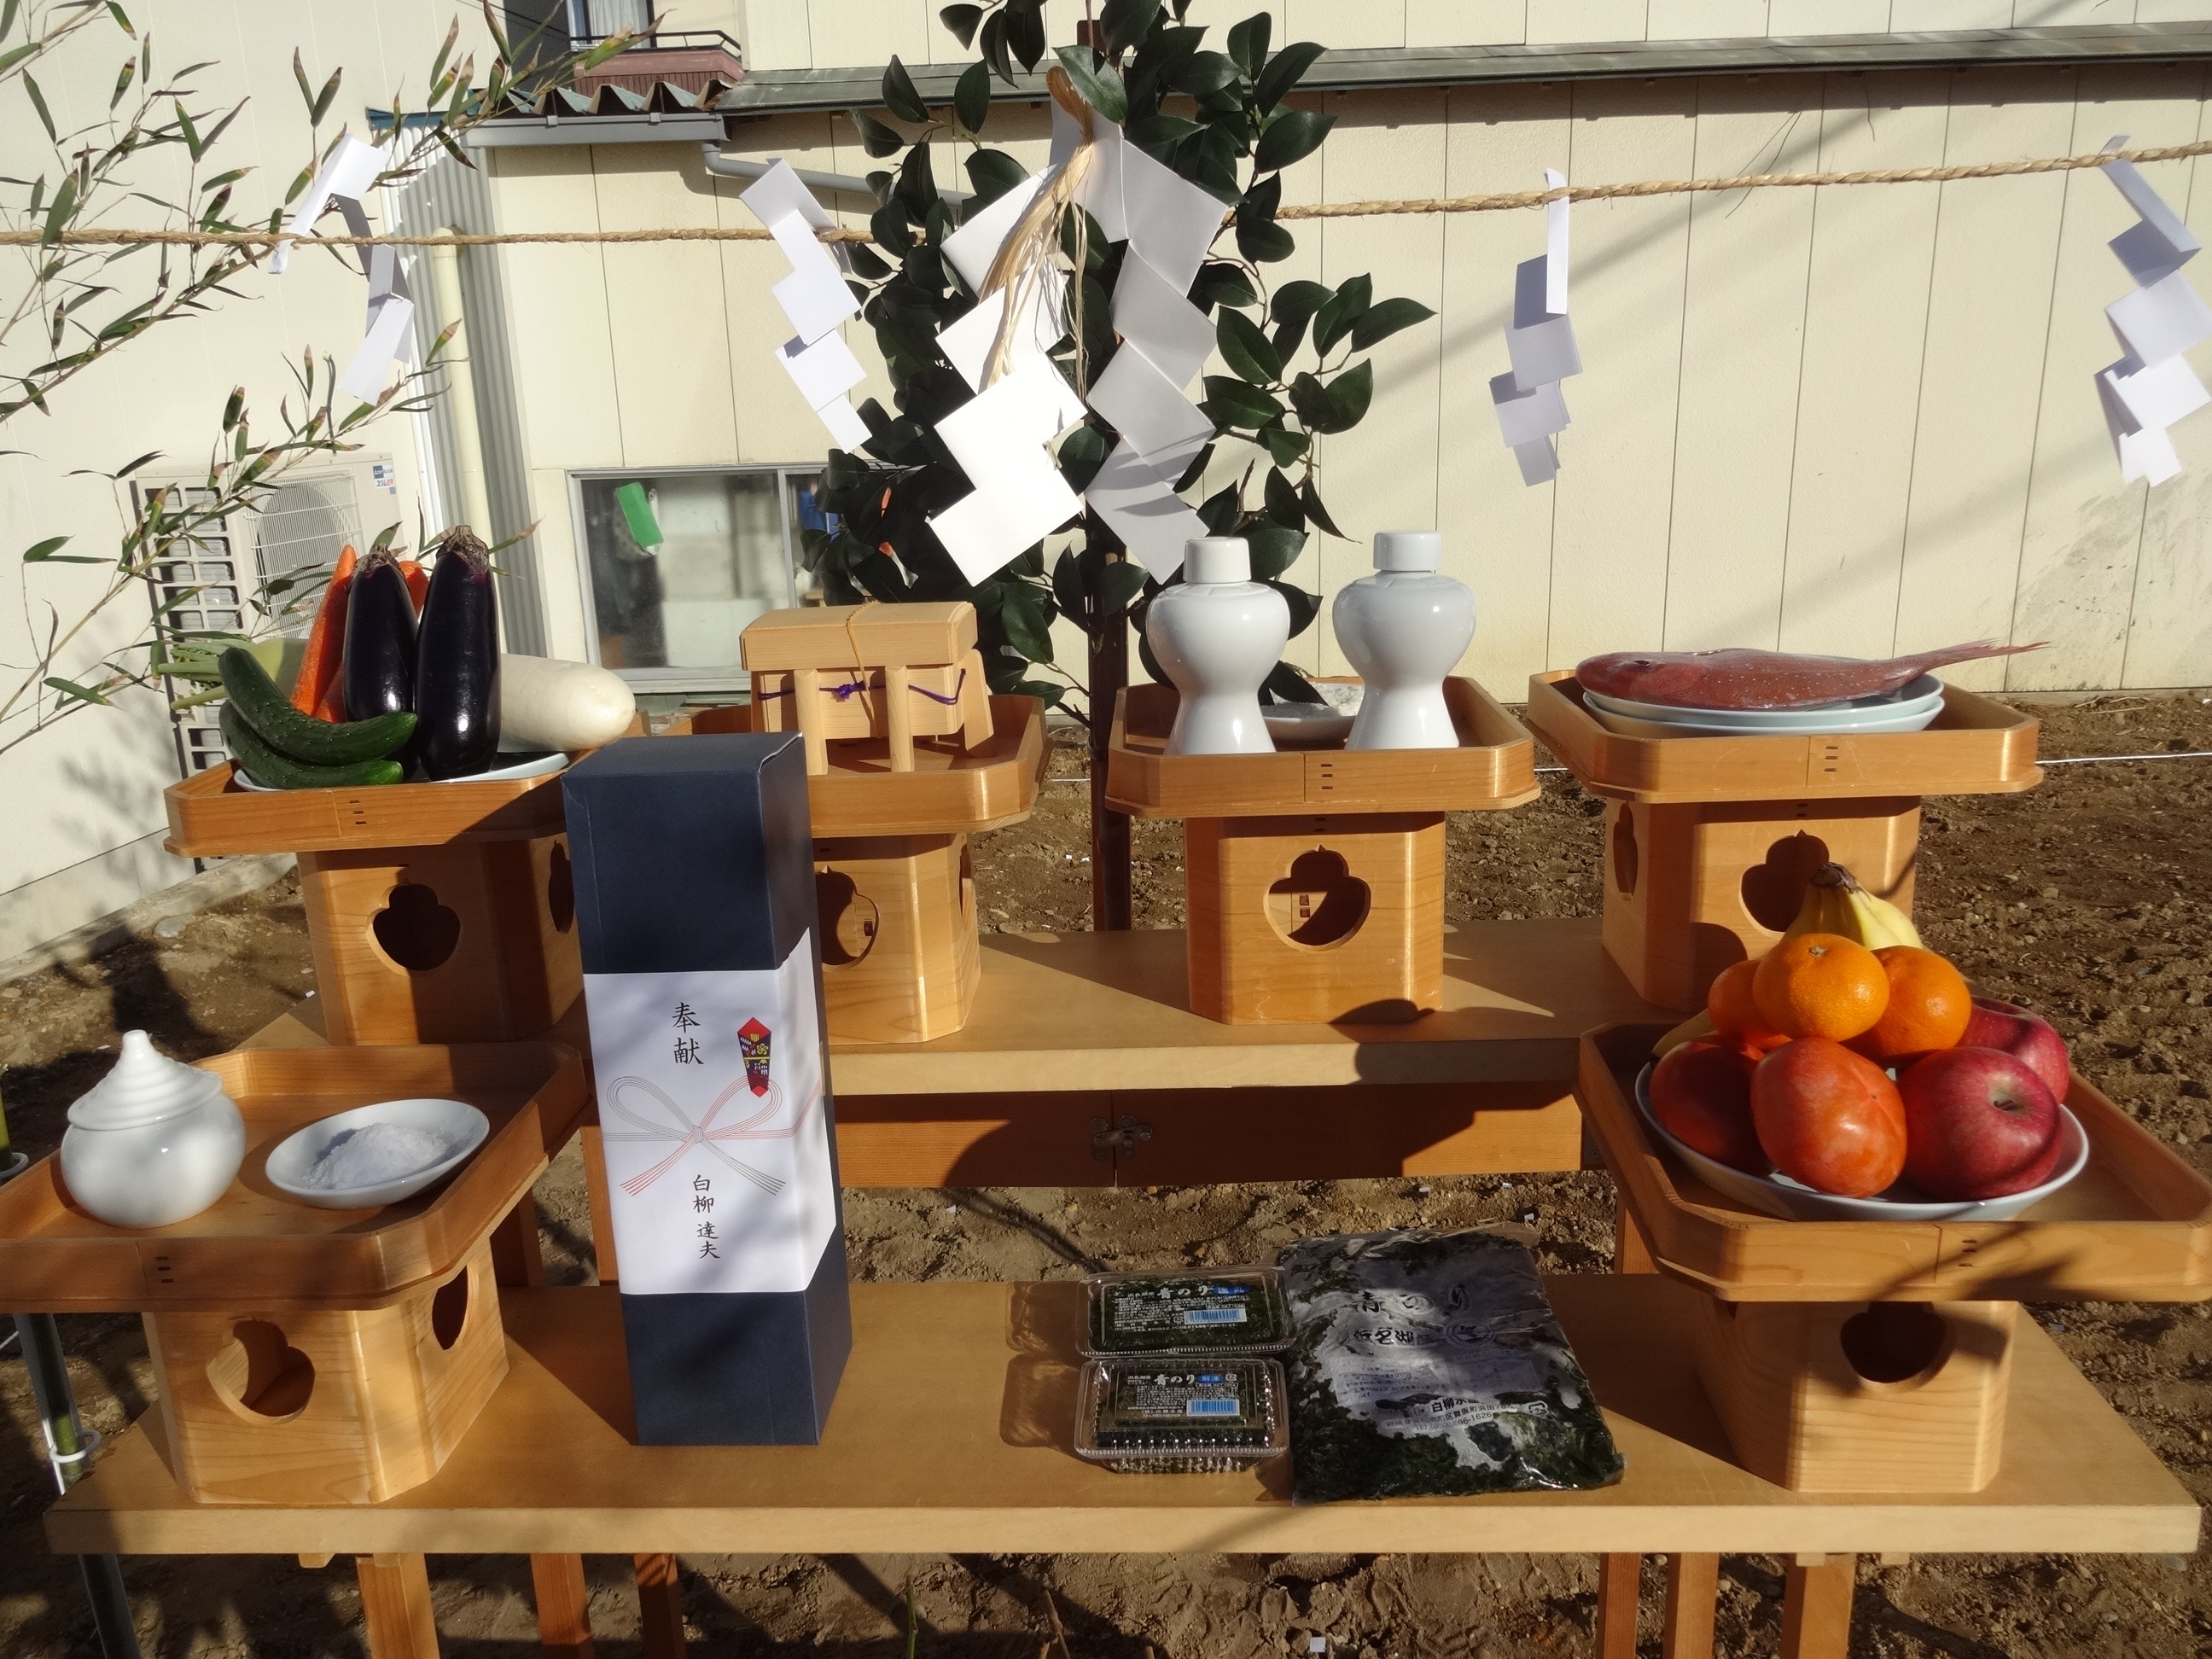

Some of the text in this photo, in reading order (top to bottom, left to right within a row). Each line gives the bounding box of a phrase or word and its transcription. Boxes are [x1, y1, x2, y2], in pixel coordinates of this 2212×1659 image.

[671, 1001, 705, 1066] 奉献
[1156, 1284, 1208, 1300] 青のり
[1353, 1327, 1435, 1346] 浜名湖
[1154, 1373, 1195, 1386] 青のり
[1431, 1397, 1477, 1413] 白柳水
